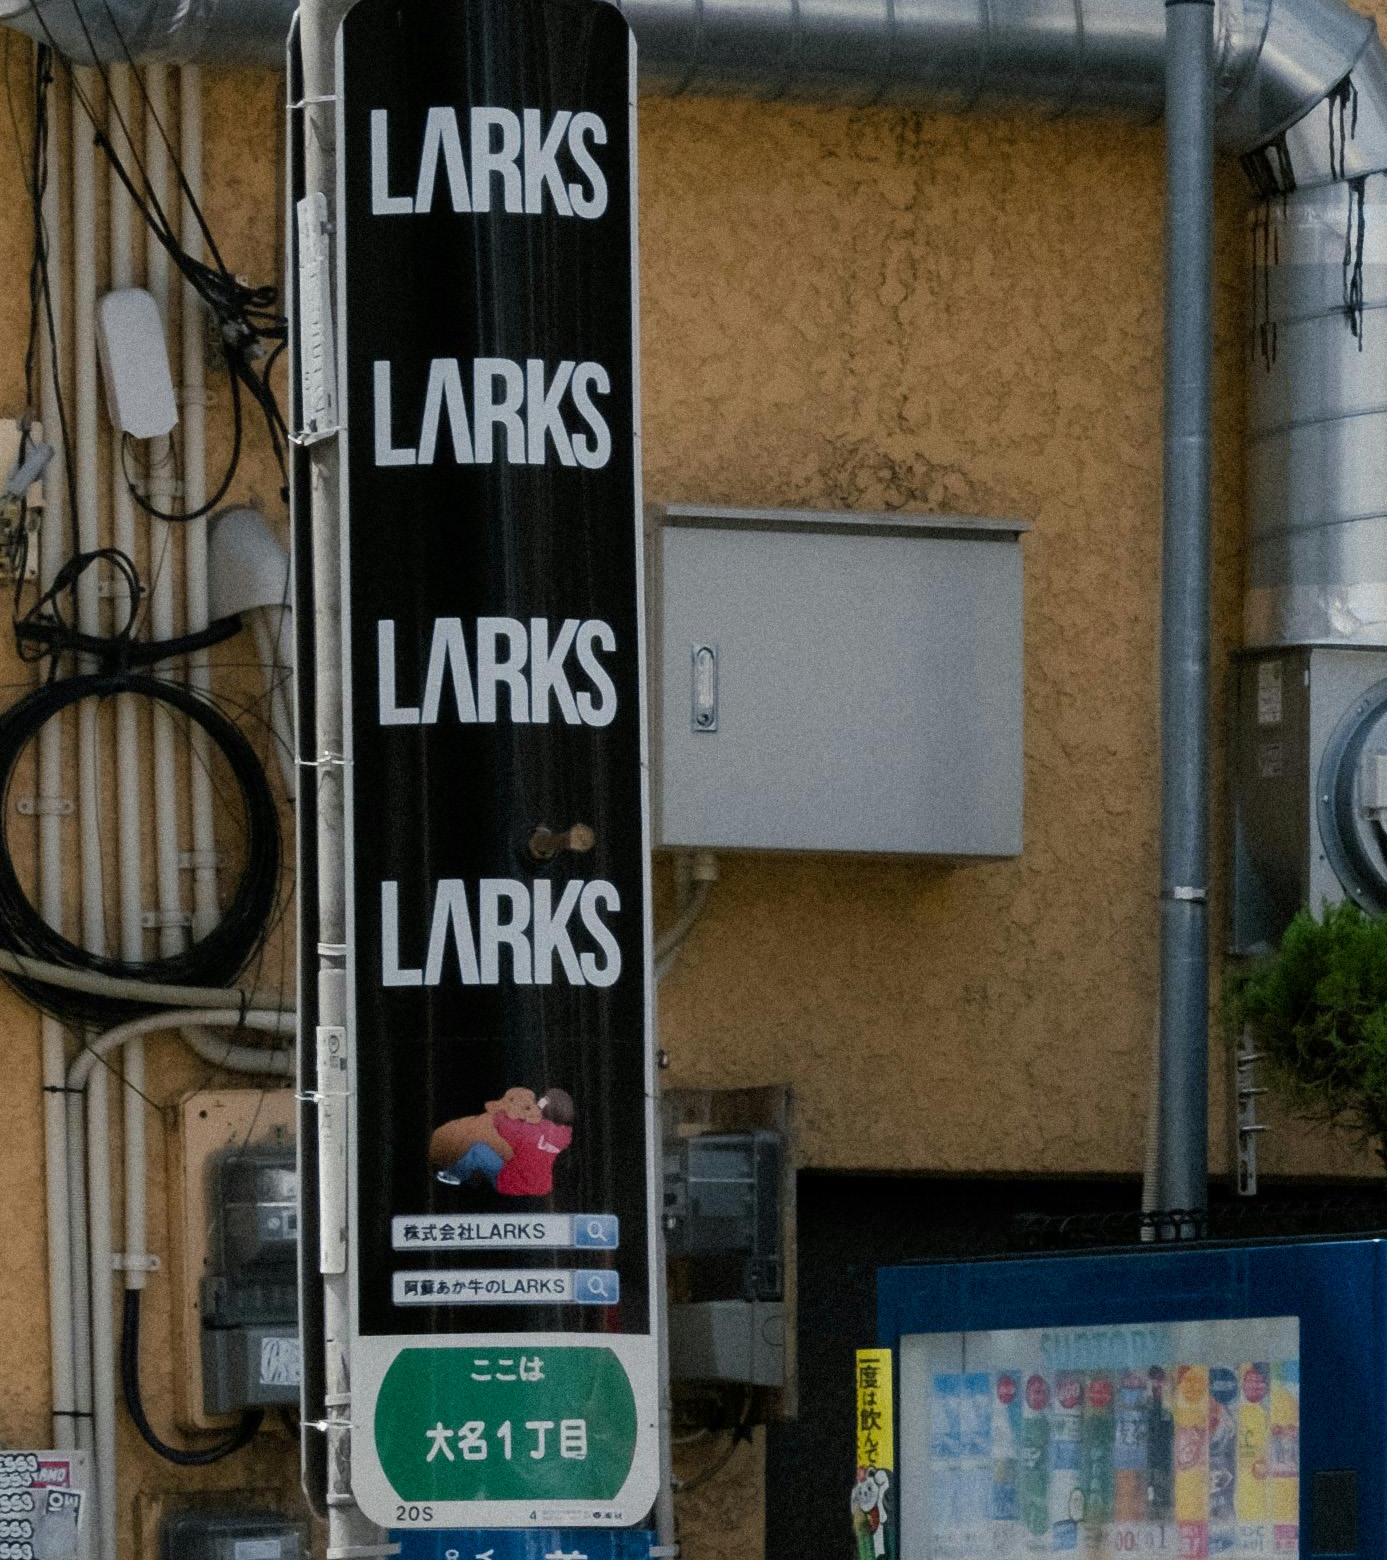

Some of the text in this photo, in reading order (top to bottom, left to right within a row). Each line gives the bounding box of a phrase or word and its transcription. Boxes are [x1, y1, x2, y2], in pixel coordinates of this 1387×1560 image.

[370, 106, 608, 220] LARKS
[373, 358, 612, 470] LARKS
[377, 616, 616, 728] LARKS
[381, 878, 621, 988] LARKS
[403, 1223, 546, 1241] 株式会社LARKS
[471, 1356, 545, 1382] ここは
[426, 1419, 588, 1463] 大名1丁目
[396, 1506, 434, 1522] 20S
